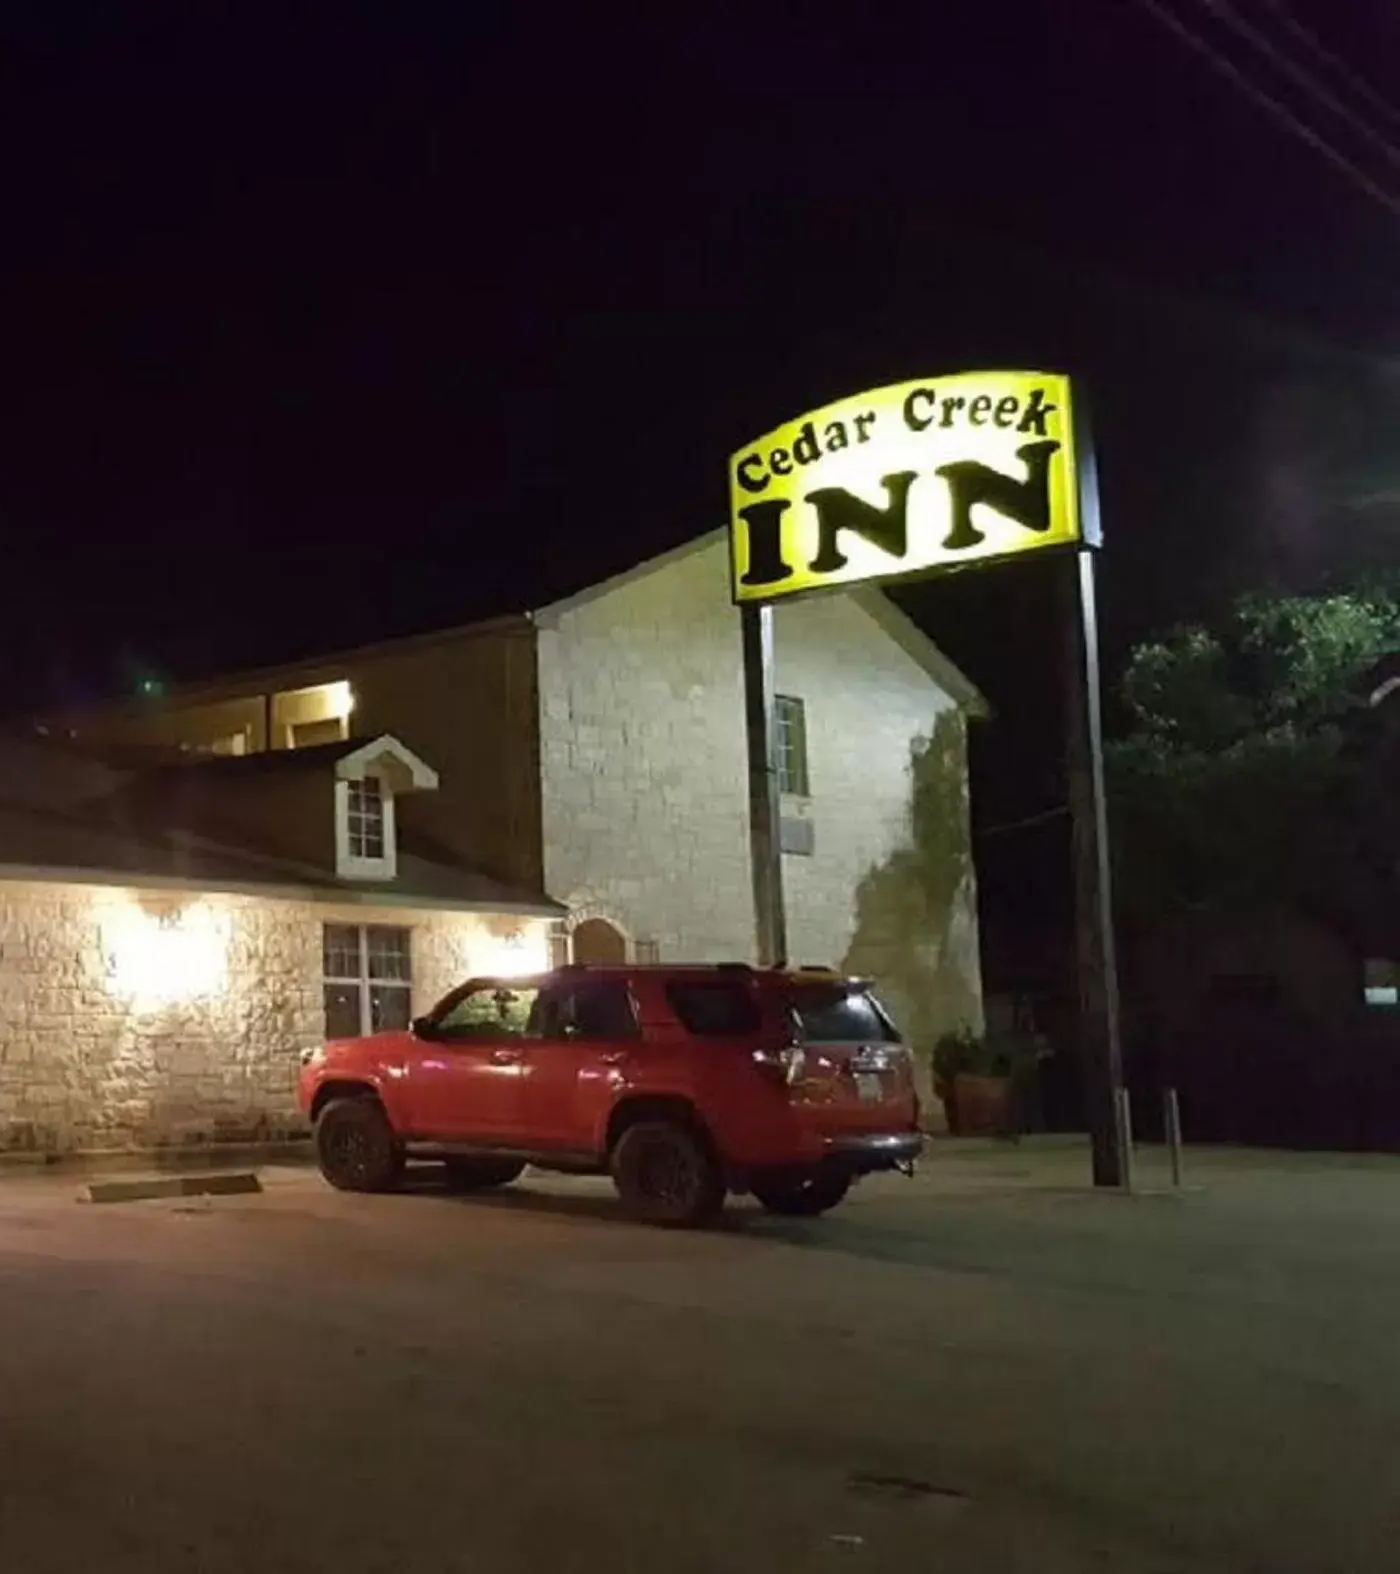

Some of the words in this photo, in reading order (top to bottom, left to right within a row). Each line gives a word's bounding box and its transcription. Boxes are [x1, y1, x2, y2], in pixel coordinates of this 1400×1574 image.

[736, 410, 876, 493] Cedar
[903, 387, 1057, 436] Creek
[737, 439, 1061, 586] INN
